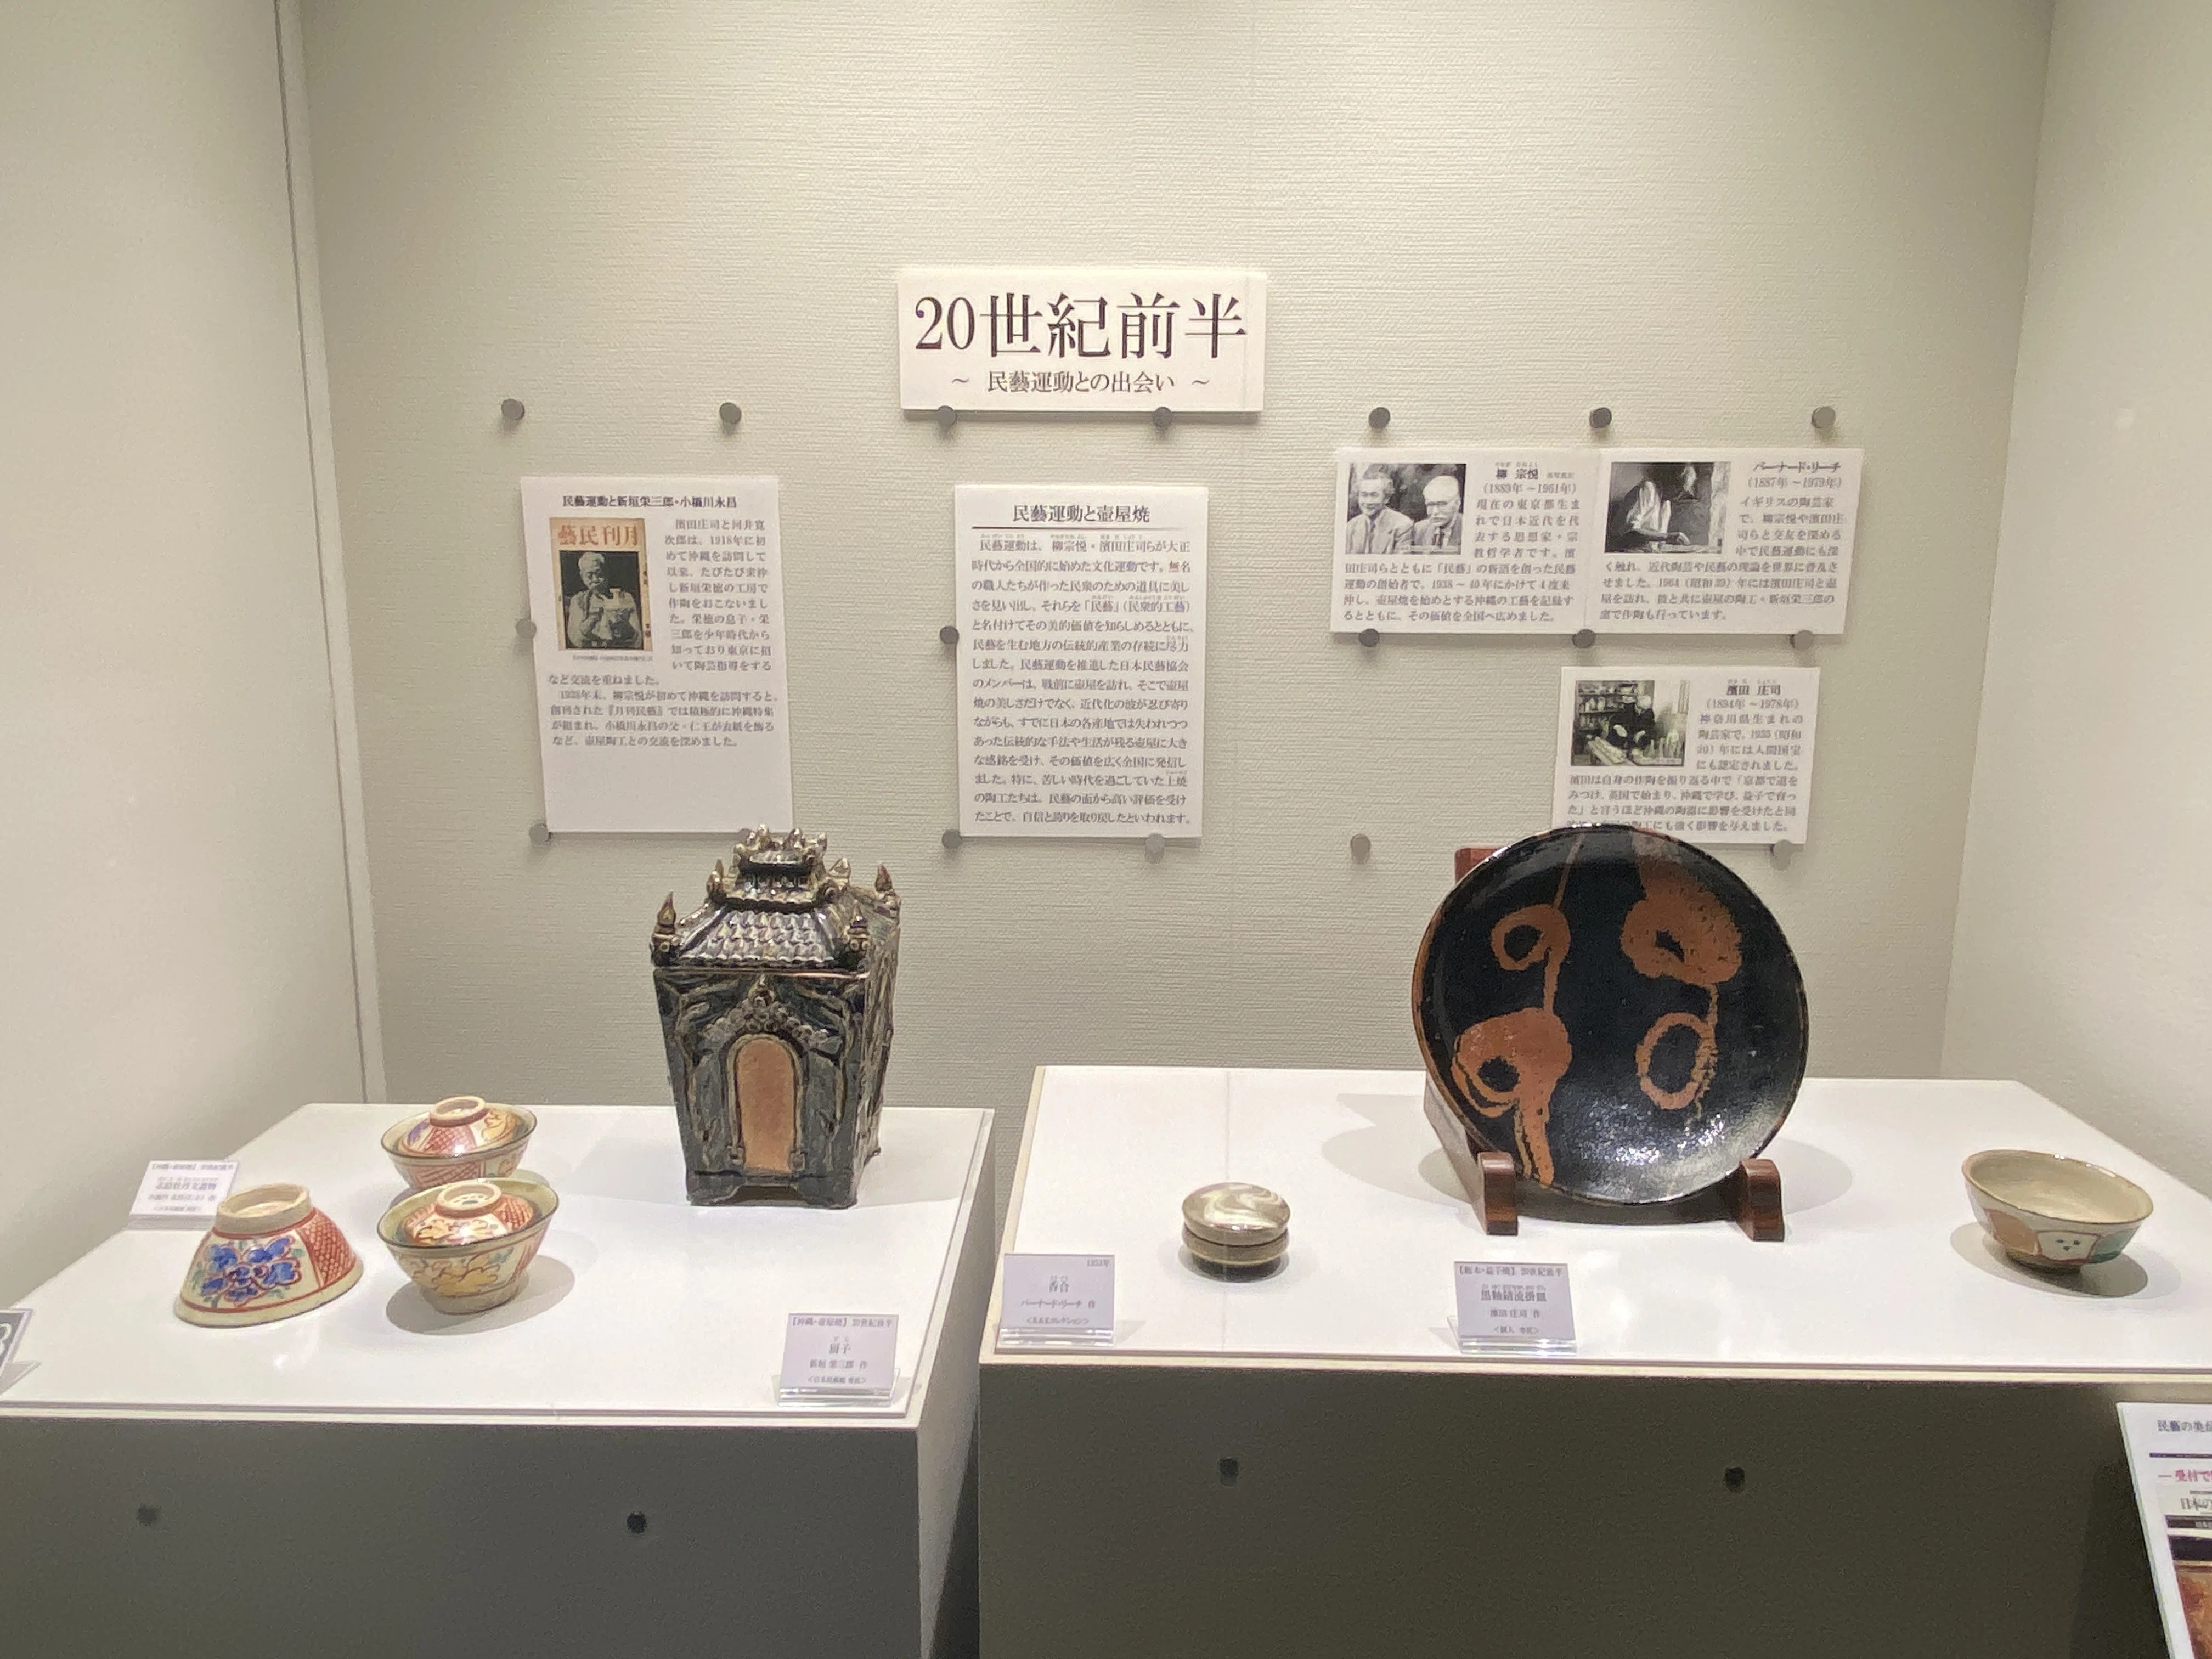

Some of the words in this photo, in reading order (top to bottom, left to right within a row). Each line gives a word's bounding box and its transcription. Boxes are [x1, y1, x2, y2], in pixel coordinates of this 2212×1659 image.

[915, 292, 1246, 359] 20世紀前半
[988, 370, 1175, 393] 民藝運動との出会い
[1013, 504, 1150, 523] 民藝運動と壺屋焼
